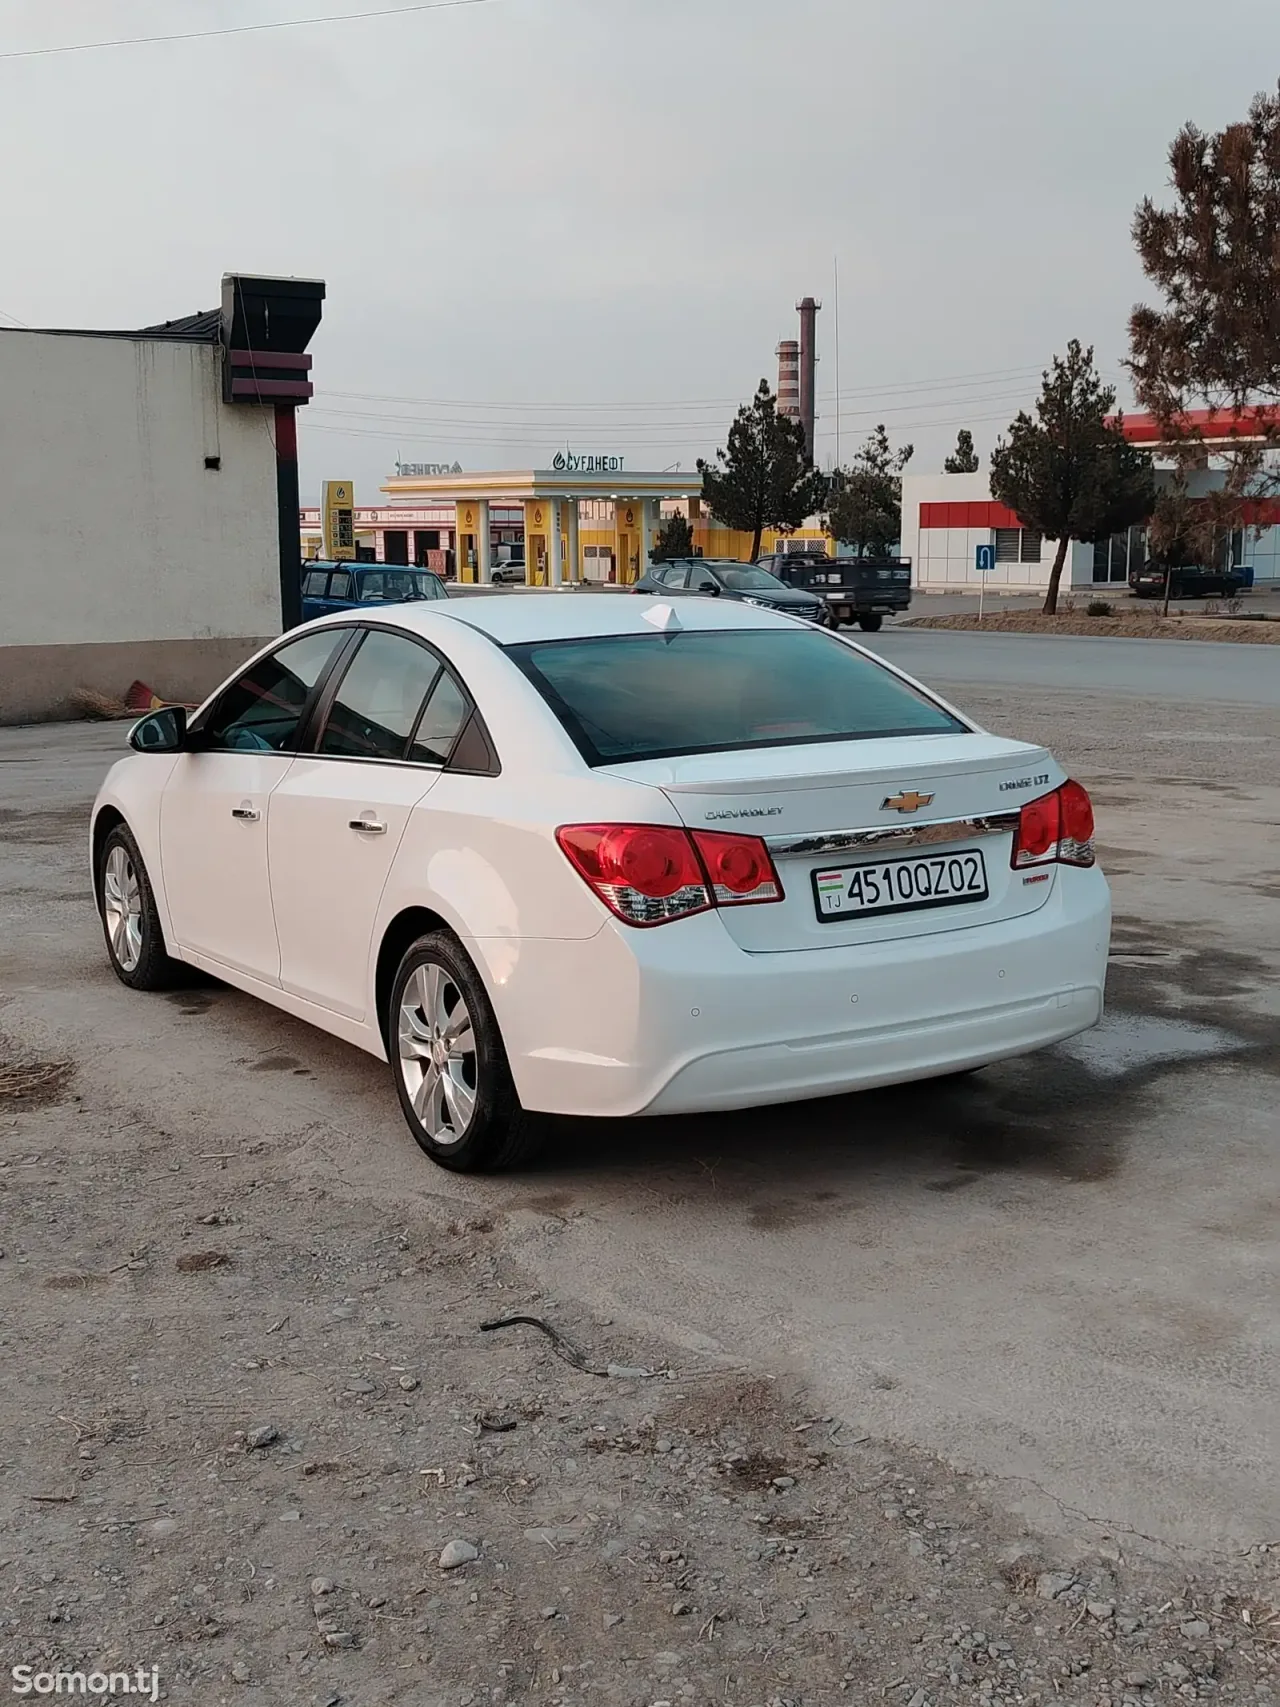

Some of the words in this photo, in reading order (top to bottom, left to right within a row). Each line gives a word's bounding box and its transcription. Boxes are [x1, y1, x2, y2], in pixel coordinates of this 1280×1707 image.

[705, 806, 784, 820] CHEVROLET
[847, 857, 981, 905] 4510QZ02
[826, 895, 841, 909] TJ
